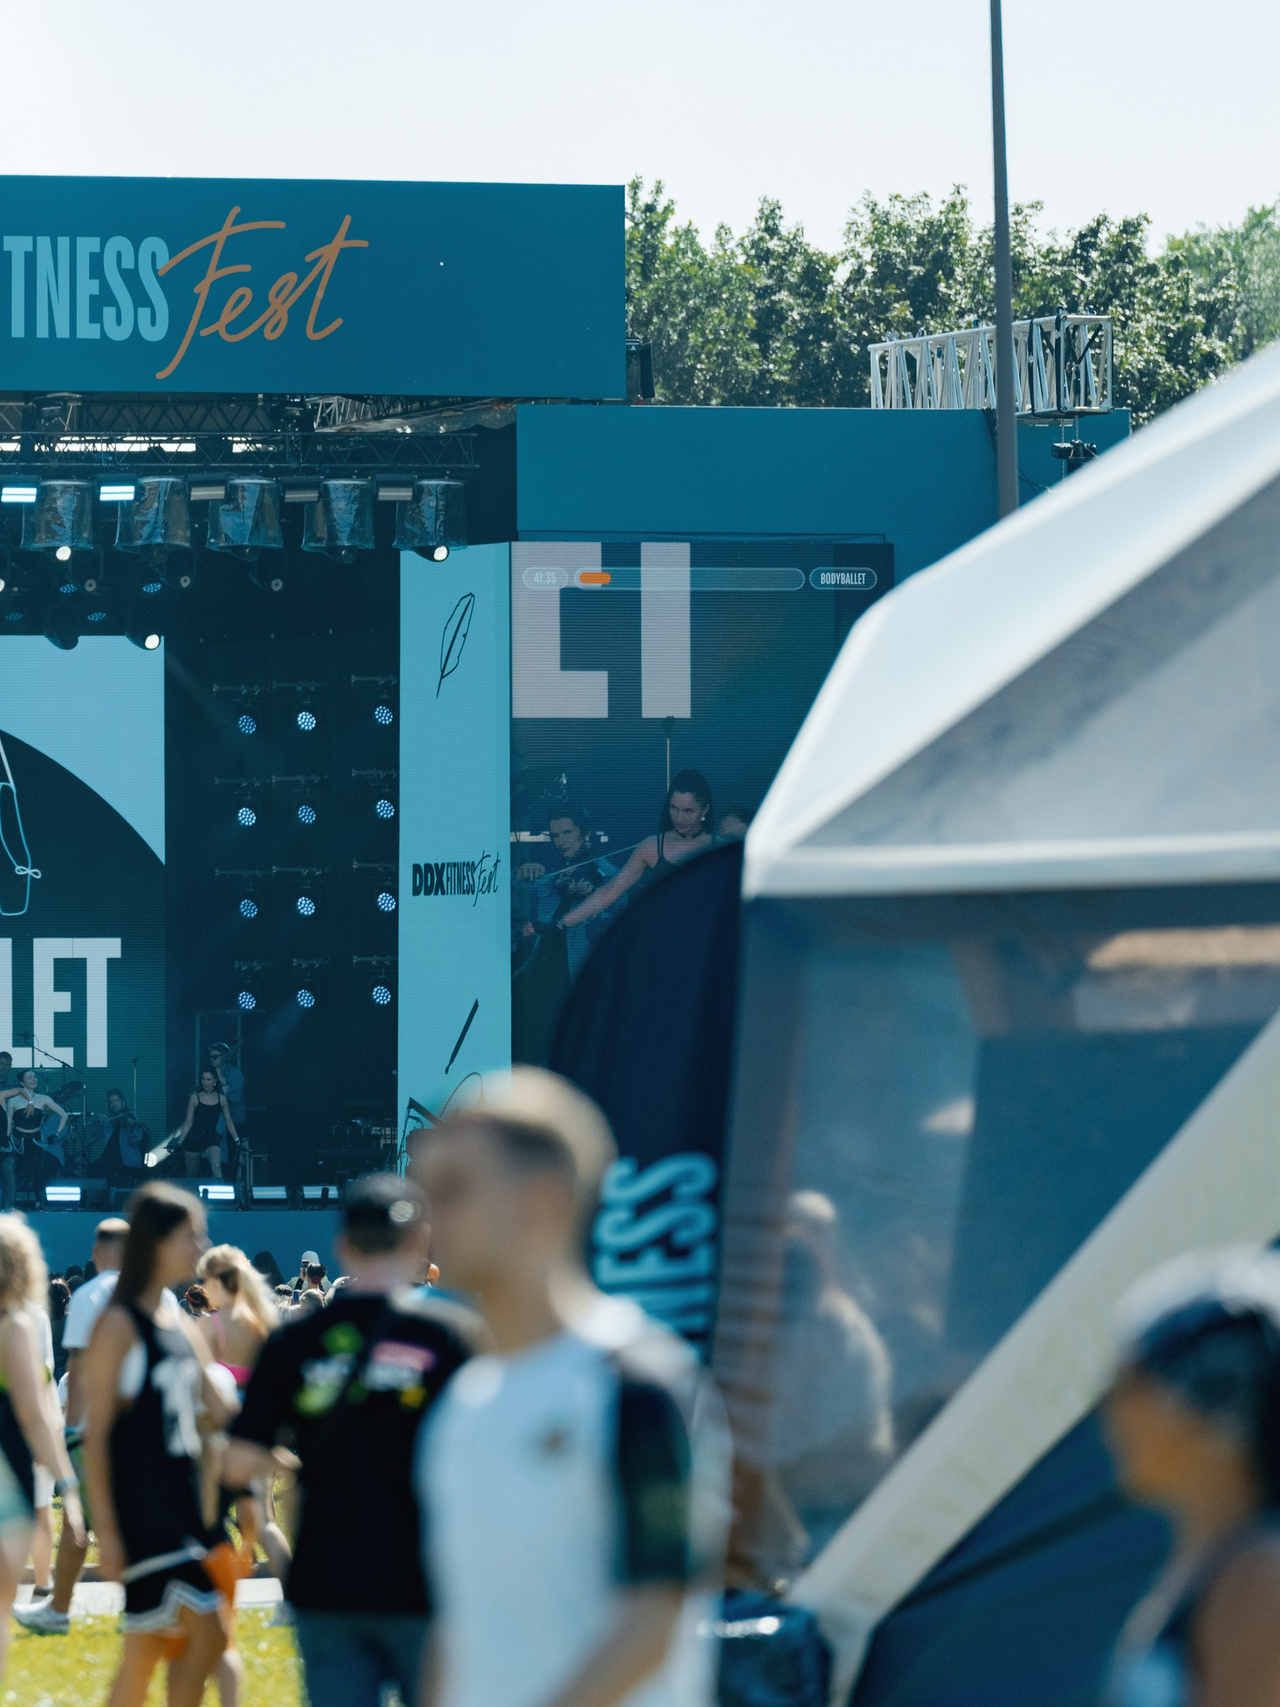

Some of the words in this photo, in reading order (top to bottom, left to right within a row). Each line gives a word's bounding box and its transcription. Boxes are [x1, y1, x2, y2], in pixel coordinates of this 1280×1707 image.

[156, 206, 369, 380] Fest
[534, 571, 557, 585] 41:35
[820, 572, 867, 585] BODYBALLET
[595, 1152, 717, 1355] NESS
